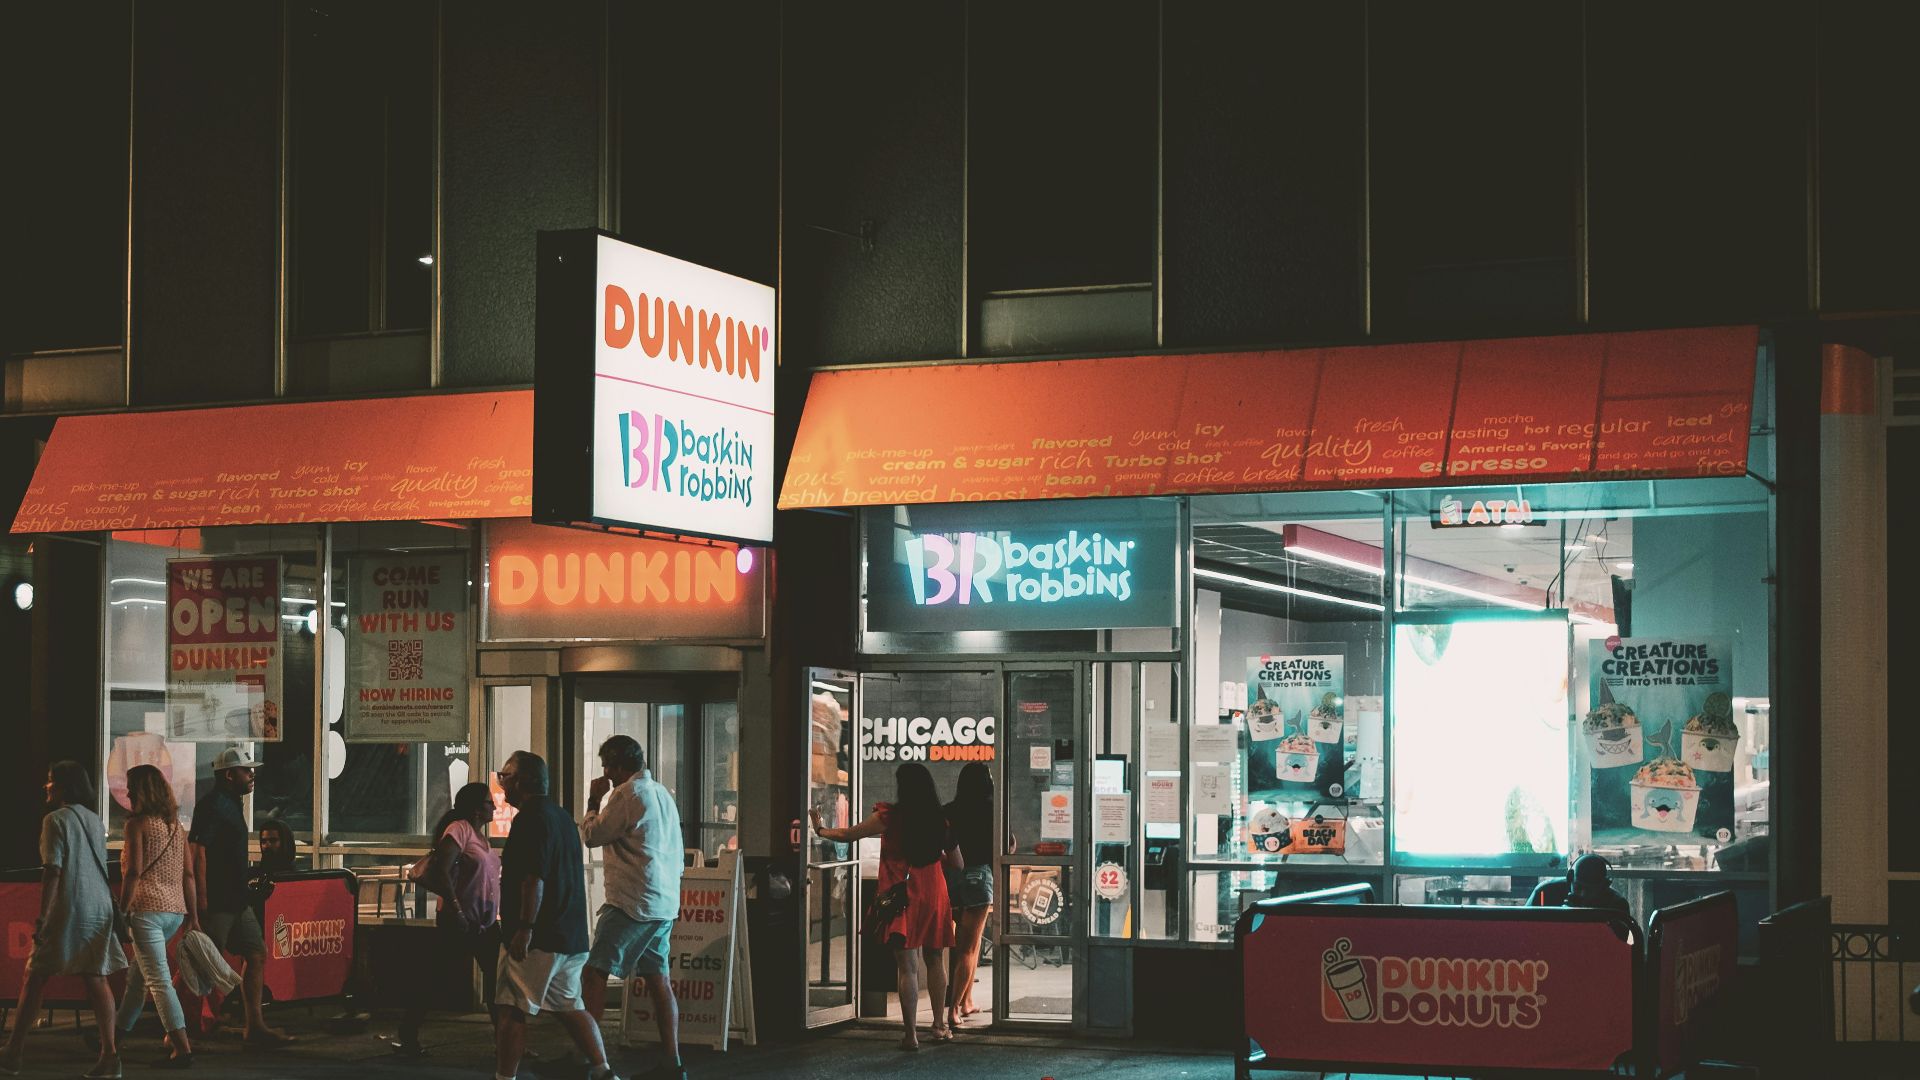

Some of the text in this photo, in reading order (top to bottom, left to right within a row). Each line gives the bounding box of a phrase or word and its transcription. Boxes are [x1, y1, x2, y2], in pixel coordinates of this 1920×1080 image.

[605, 284, 768, 383] DUNKIN'
[1355, 417, 1404, 432] fresh
[1558, 418, 1651, 437] regular
[1668, 414, 1712, 427] iced
[1195, 423, 1224, 437] icy
[1277, 429, 1317, 438] flavor
[1398, 427, 1508, 443] great tasting
[1525, 425, 1550, 434] hot
[680, 420, 752, 471] baskin
[1032, 437, 1112, 449] flavored
[1129, 430, 1178, 446] yum
[1158, 440, 1191, 451] cold
[1653, 430, 1733, 446] caramel
[619, 410, 678, 492] BR
[1261, 435, 1372, 467] quality
[1383, 446, 1434, 458] coffee
[1459, 441, 1606, 453] America's Favorite
[847, 449, 933, 461] pick-me-up
[1040, 450, 1092, 469] rich
[1104, 455, 1167, 467] Turbo
[1599, 452, 1620, 460] and
[1643, 450, 1667, 458] And
[344, 460, 368, 471] icy
[406, 464, 438, 473] flavor
[467, 456, 505, 470] fresh
[883, 457, 1034, 470] cream & sugar
[1419, 457, 1547, 475] espresso
[217, 470, 280, 482] flavored
[291, 464, 330, 479] yum
[500, 469, 532, 480] grea
[1115, 472, 1161, 481] genuine
[1174, 465, 1301, 483] coffee break
[1314, 466, 1393, 476] Invigorating
[313, 474, 340, 484] cold
[390, 472, 477, 499] quality
[680, 465, 752, 507] robbins
[869, 474, 925, 486] variety
[1045, 474, 1096, 486] bean
[71, 482, 140, 494] pick-me-up
[219, 484, 260, 500] rich
[270, 487, 318, 498] Turbo
[484, 482, 524, 493] coffee
[842, 485, 938, 503] brewed
[98, 490, 216, 502] cream & sugar
[428, 499, 490, 508] Invigorating
[220, 504, 260, 514] bean
[320, 498, 419, 512] coffee break
[1467, 500, 1533, 524] ATM
[62, 514, 137, 531] brewed
[1002, 530, 1128, 569] baskin
[373, 566, 440, 586] COME
[905, 532, 1002, 605] BR
[181, 566, 264, 590] WE ARE
[499, 548, 752, 605] DUNKIN'
[1006, 565, 1131, 602] robbins
[383, 589, 428, 609] RUN
[173, 596, 275, 636] OPEN
[358, 611, 455, 633] WITH US
[1613, 641, 1708, 660] CREATURE
[172, 646, 275, 671] DUNKIN'
[1265, 659, 1325, 670] CREATURE
[1602, 658, 1719, 677] CREATIONS
[1258, 670, 1332, 681] CREATIONS
[1626, 677, 1695, 686] INTO THE SEA
[360, 688, 454, 702] NOW HIRING
[863, 716, 995, 745] CHICAGO
[863, 746, 895, 761] UNS
[900, 745, 926, 761] ON
[1308, 838, 1331, 846] DAY
[1101, 871, 1118, 885] $2
[681, 889, 725, 906] KIN'
[678, 909, 724, 923] IVERS
[292, 919, 345, 939] DUNKIN'
[292, 938, 343, 957] DONUTS
[680, 953, 721, 970] Eats
[1381, 957, 1548, 994] DUNKIN'
[633, 978, 714, 1000] GBHUB
[1345, 989, 1362, 1002] DD
[1382, 991, 1541, 1029] DONUTS
